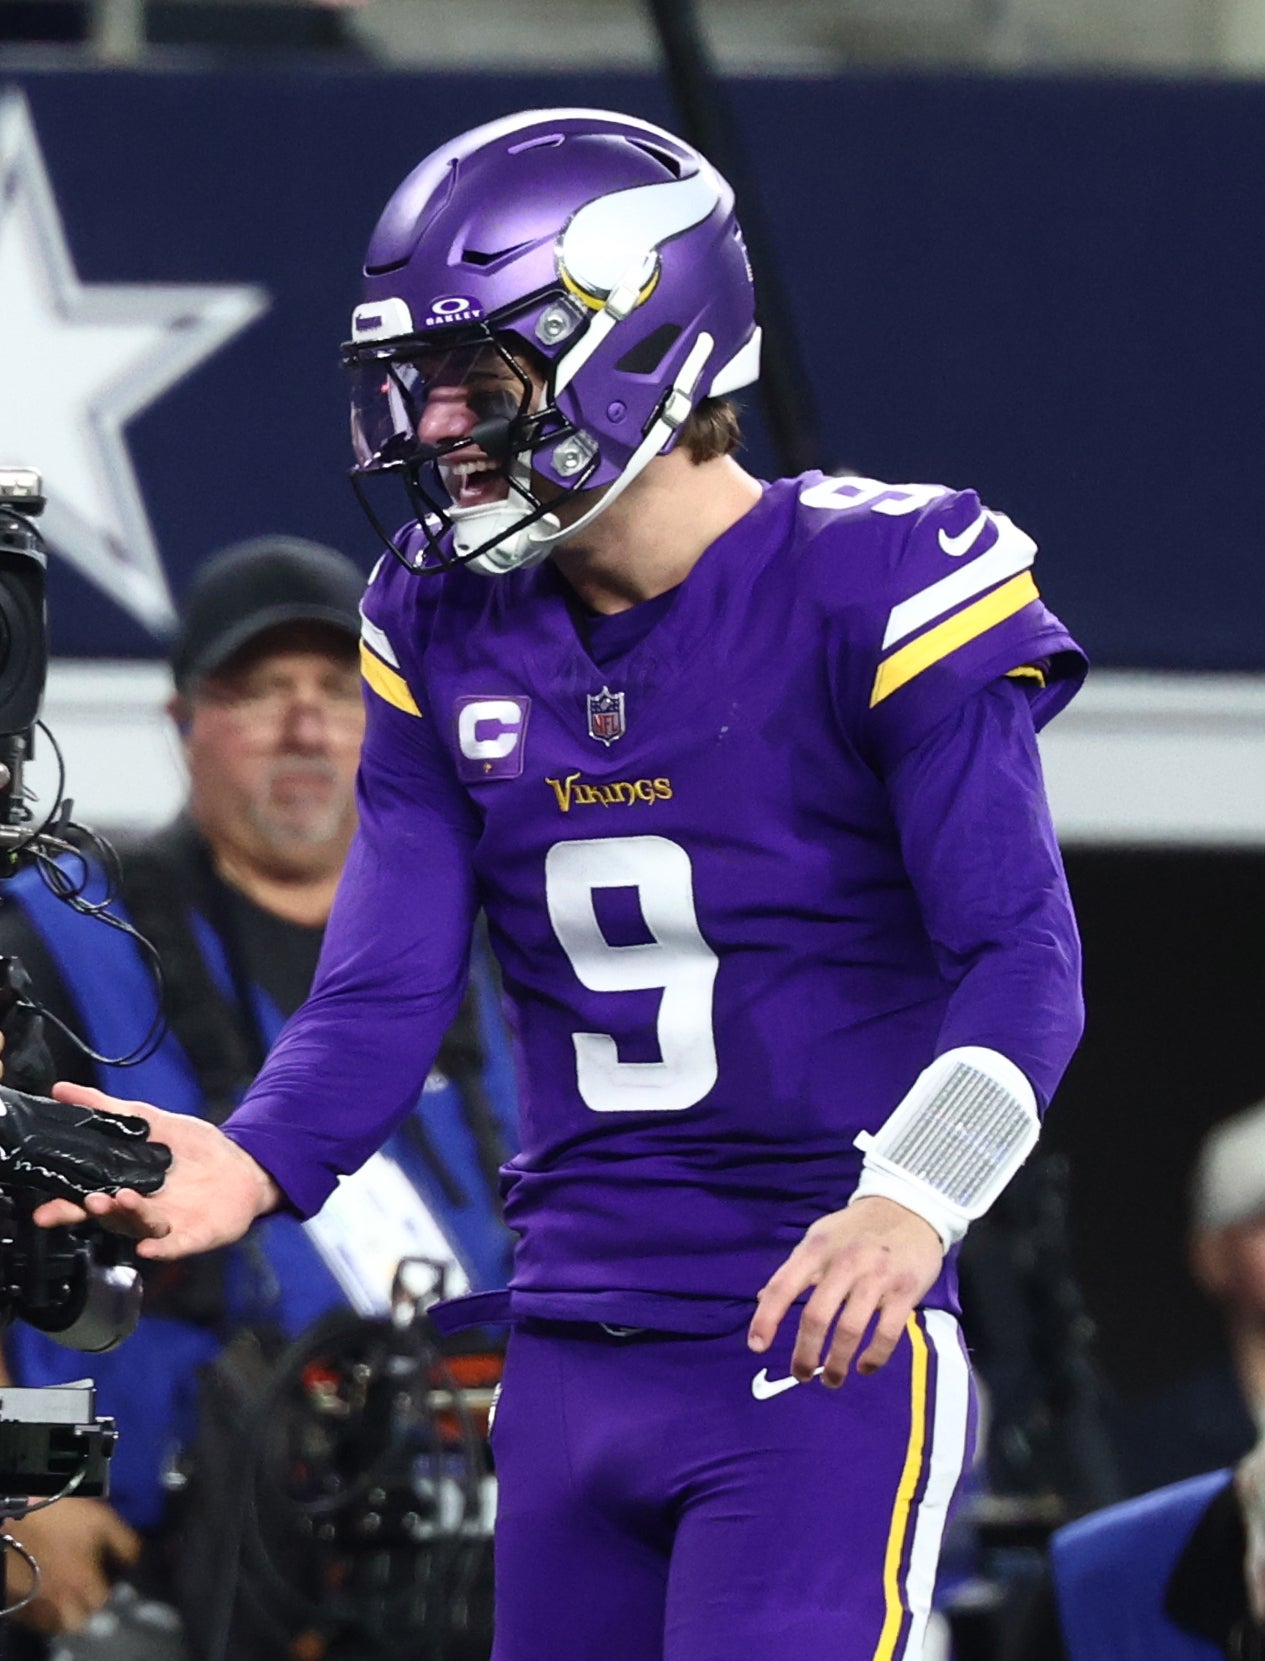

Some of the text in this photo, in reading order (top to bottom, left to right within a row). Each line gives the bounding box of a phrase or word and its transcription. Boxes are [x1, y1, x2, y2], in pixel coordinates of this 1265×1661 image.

[425, 309, 481, 326] OAKLEY
[799, 476, 947, 517] 9
[458, 700, 522, 761] C
[593, 714, 620, 735] NFL
[544, 834, 720, 1113] 9
